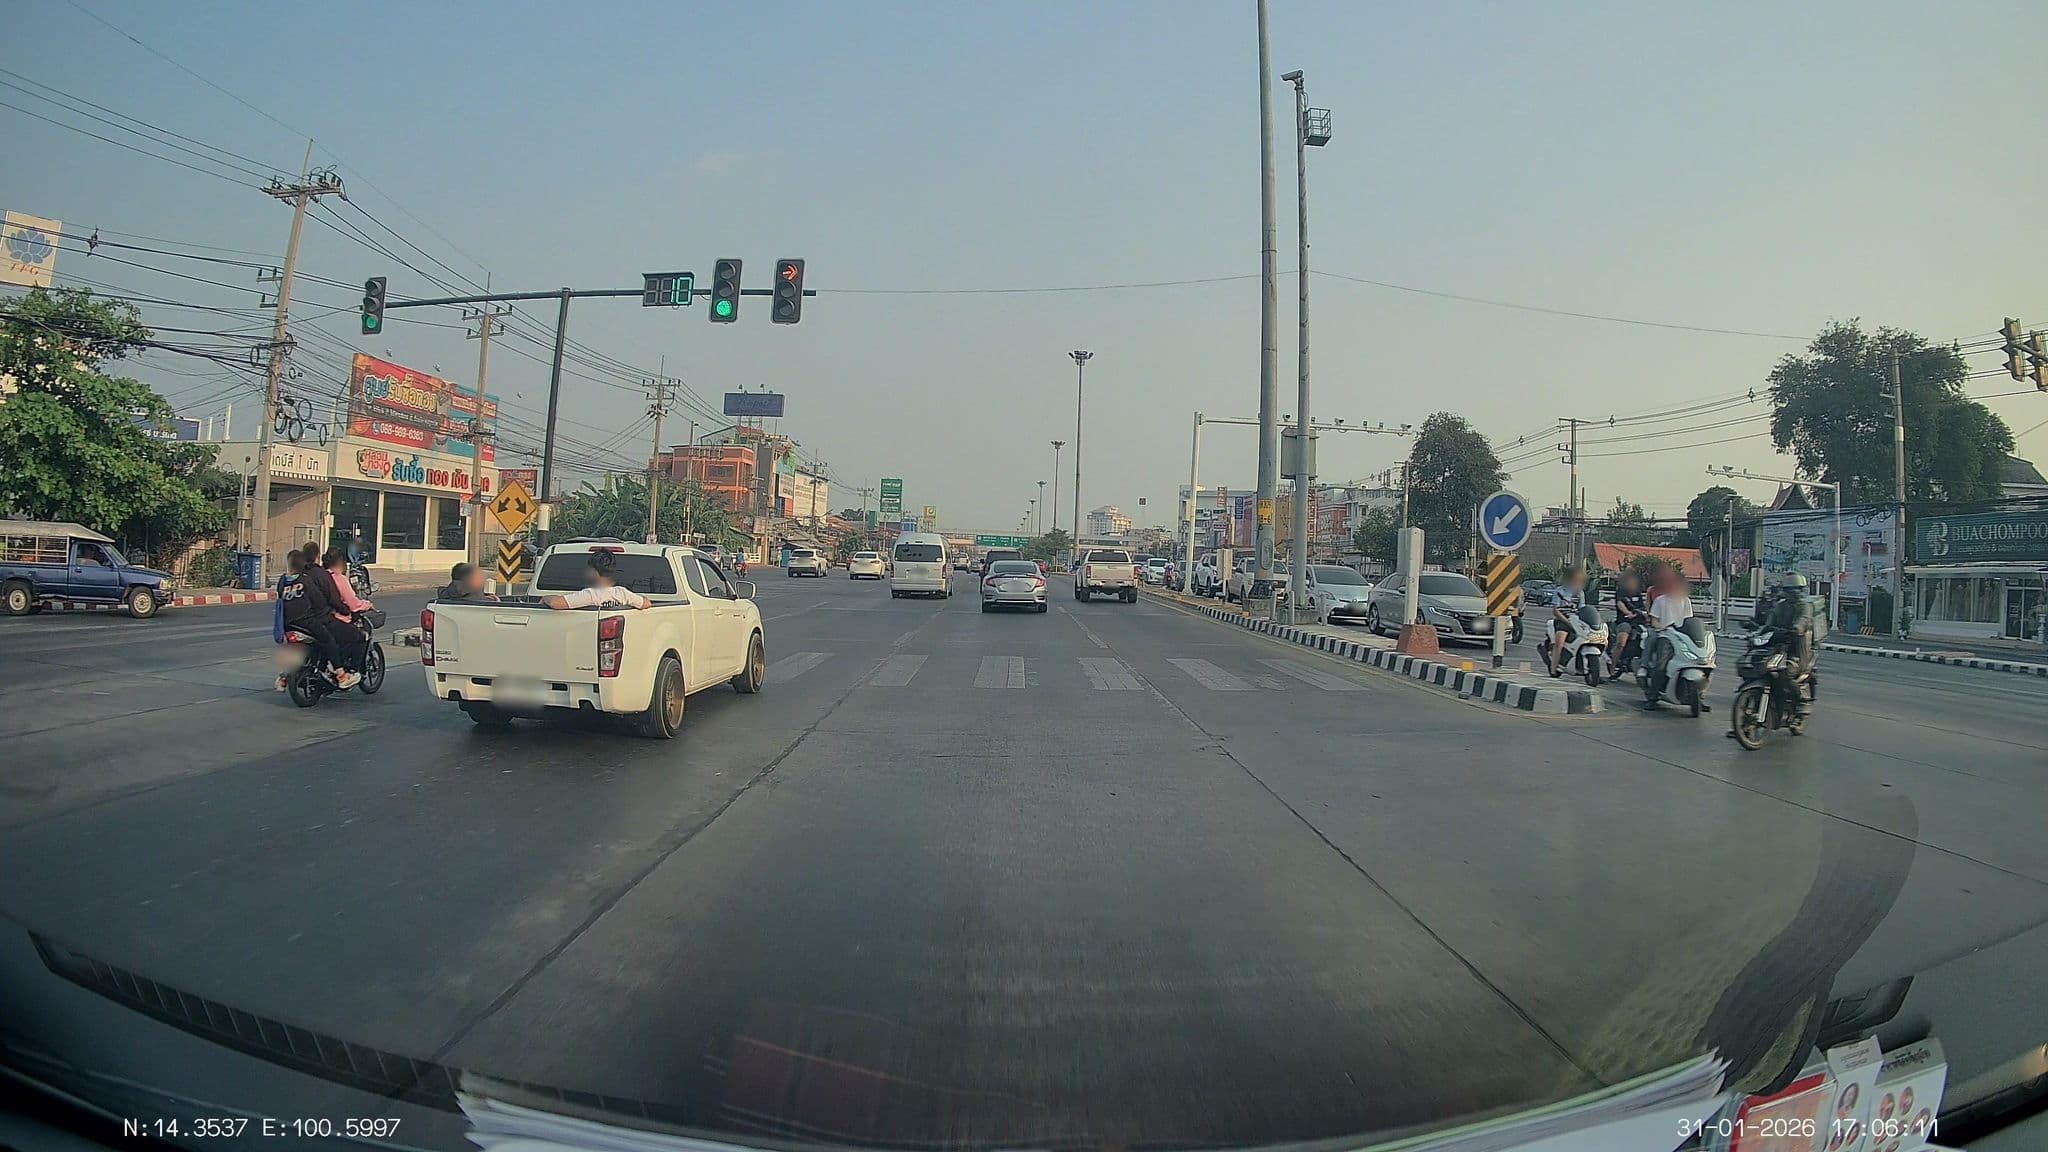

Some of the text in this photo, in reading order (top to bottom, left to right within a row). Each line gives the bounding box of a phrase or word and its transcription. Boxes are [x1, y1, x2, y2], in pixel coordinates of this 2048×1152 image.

[392, 454, 425, 484] รับซื้อ
[426, 468, 449, 486] ทอง
[1951, 522, 2048, 541] BUACHOMPOO
